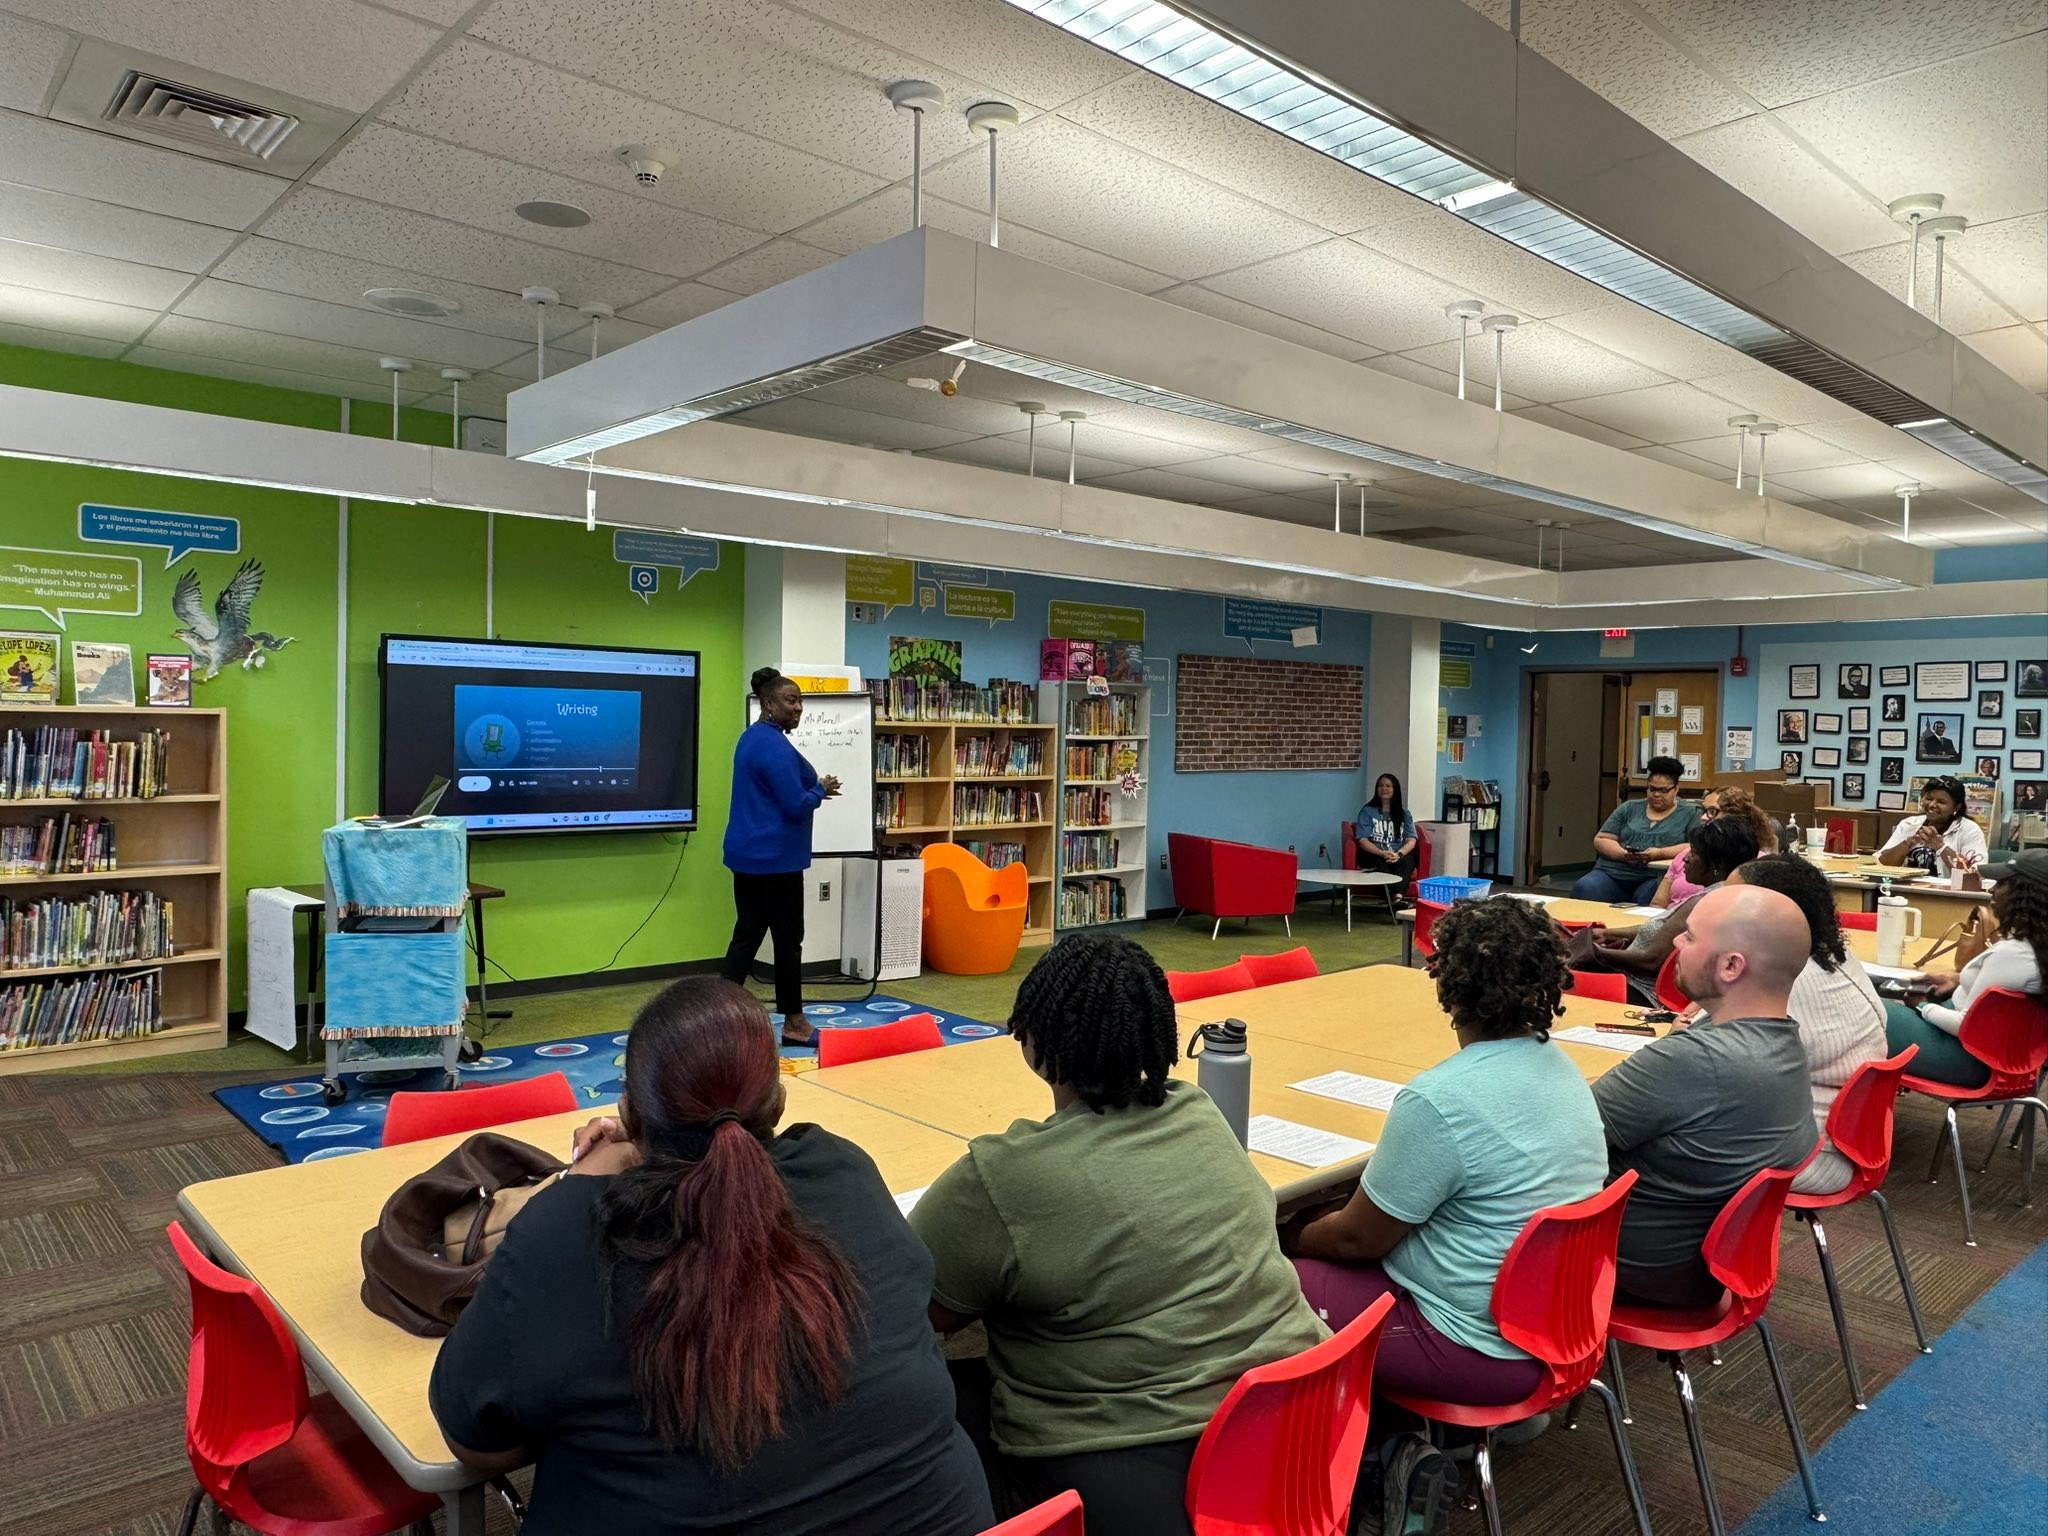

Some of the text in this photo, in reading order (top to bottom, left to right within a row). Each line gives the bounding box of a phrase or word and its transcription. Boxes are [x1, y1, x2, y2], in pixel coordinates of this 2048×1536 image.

[92, 512, 108, 521] Los
[40, 567, 64, 575] man
[66, 568, 88, 577] who
[89, 570, 108, 579] has
[62, 577, 81, 587] has
[34, 587, 95, 599] Muhammad
[96, 591, 111, 600] Ali
[25, 639, 51, 653] LOPEZ
[889, 639, 962, 675] GRAPHIC
[556, 703, 599, 717] Writing
